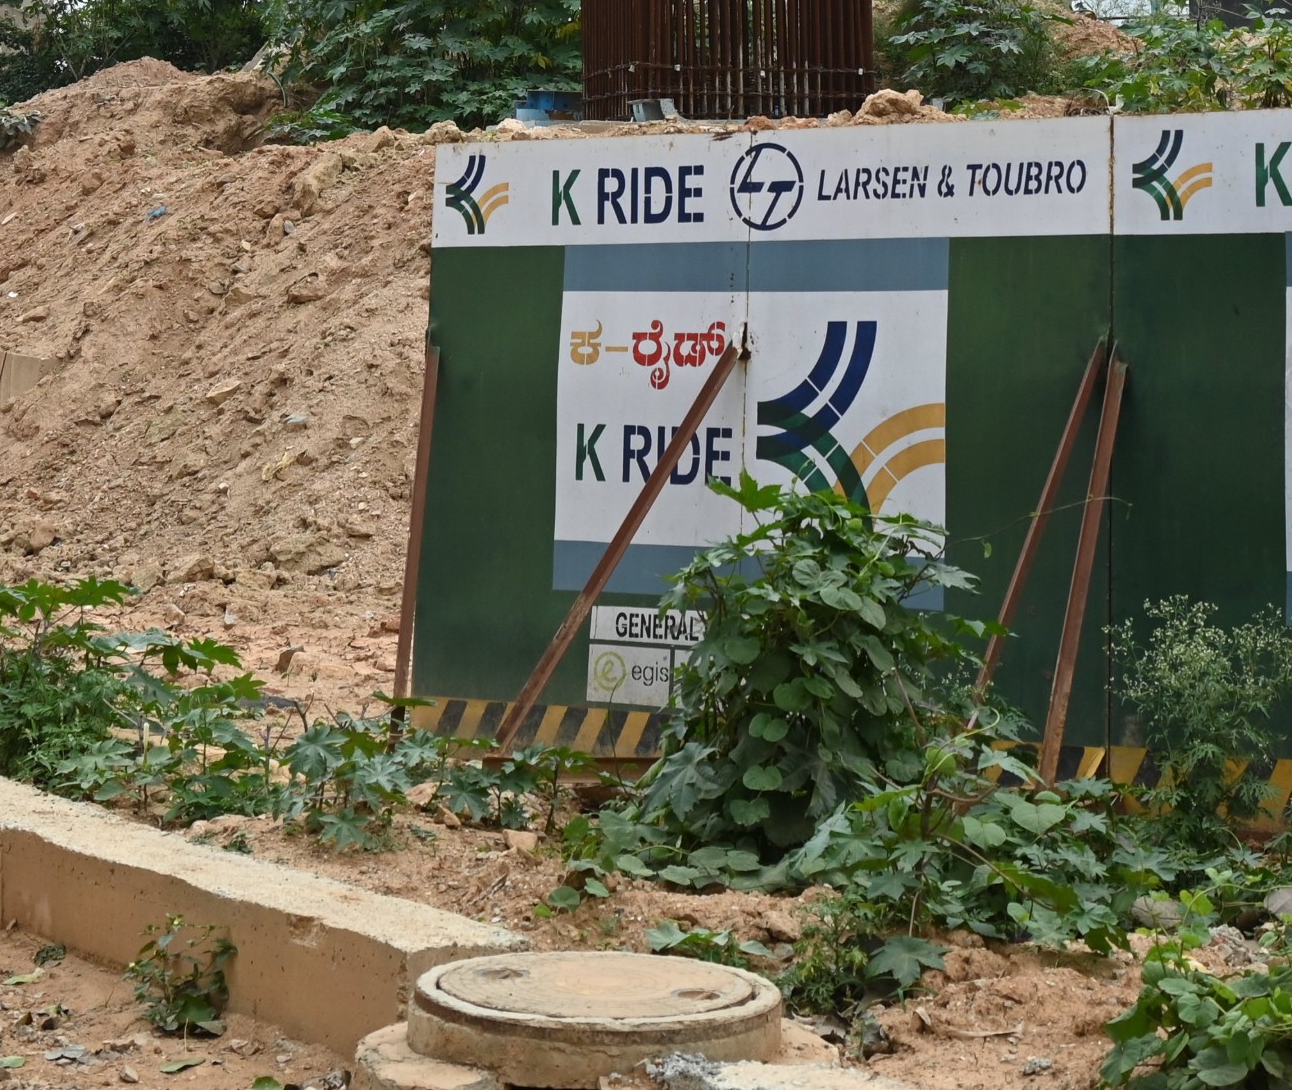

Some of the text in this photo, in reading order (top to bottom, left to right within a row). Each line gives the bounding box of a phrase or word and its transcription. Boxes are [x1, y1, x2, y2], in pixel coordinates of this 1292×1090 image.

[552, 164, 705, 226] K RIDE
[817, 159, 1087, 201] LARSEN & TOUBRO
[575, 423, 733, 487] K RIDE
[615, 612, 699, 642] GENERAL
[631, 661, 669, 686] egis
